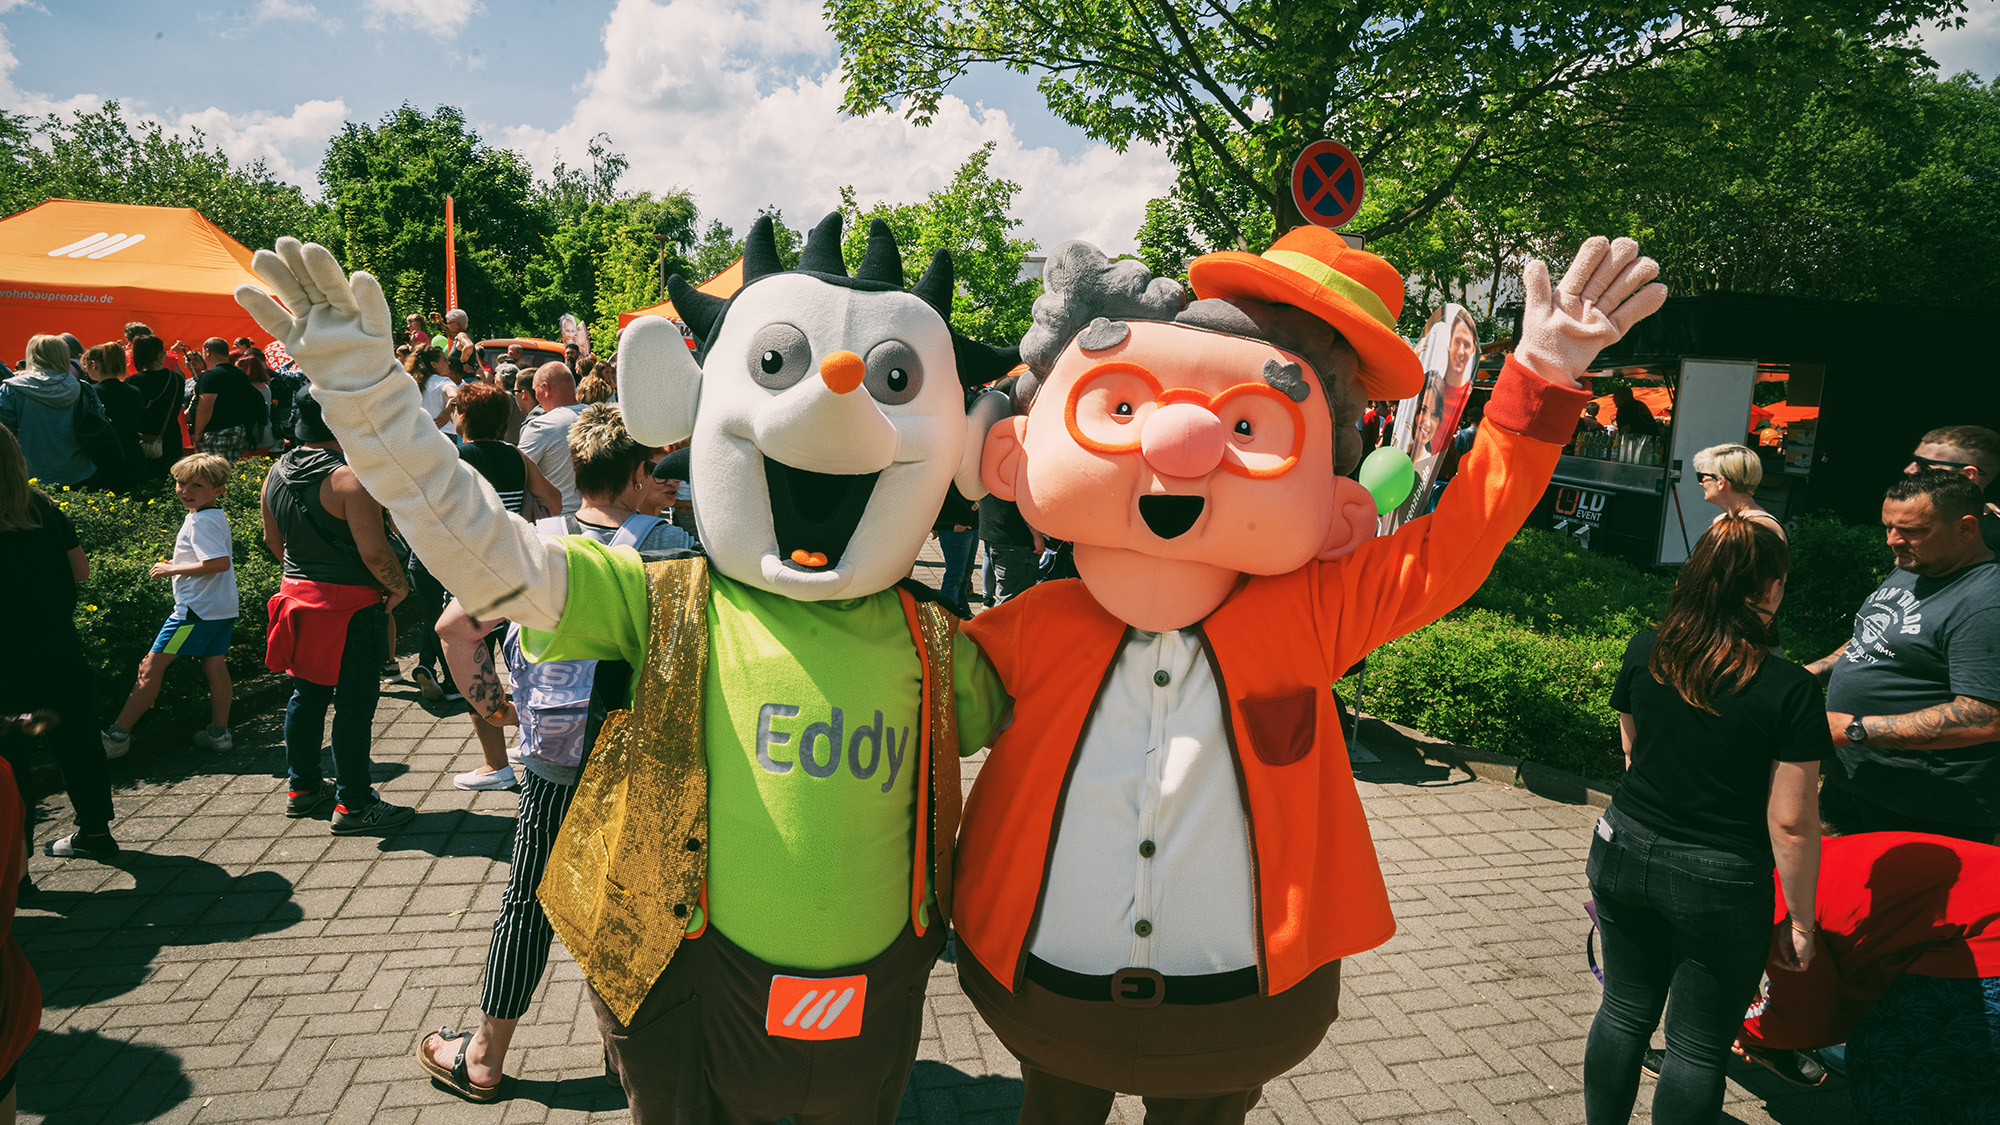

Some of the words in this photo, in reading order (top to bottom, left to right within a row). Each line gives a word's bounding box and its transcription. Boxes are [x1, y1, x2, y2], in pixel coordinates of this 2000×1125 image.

[1404, 465, 1430, 524] renzlau.de
[1576, 509, 1602, 522] EVENT
[756, 702, 910, 793] Eddy
